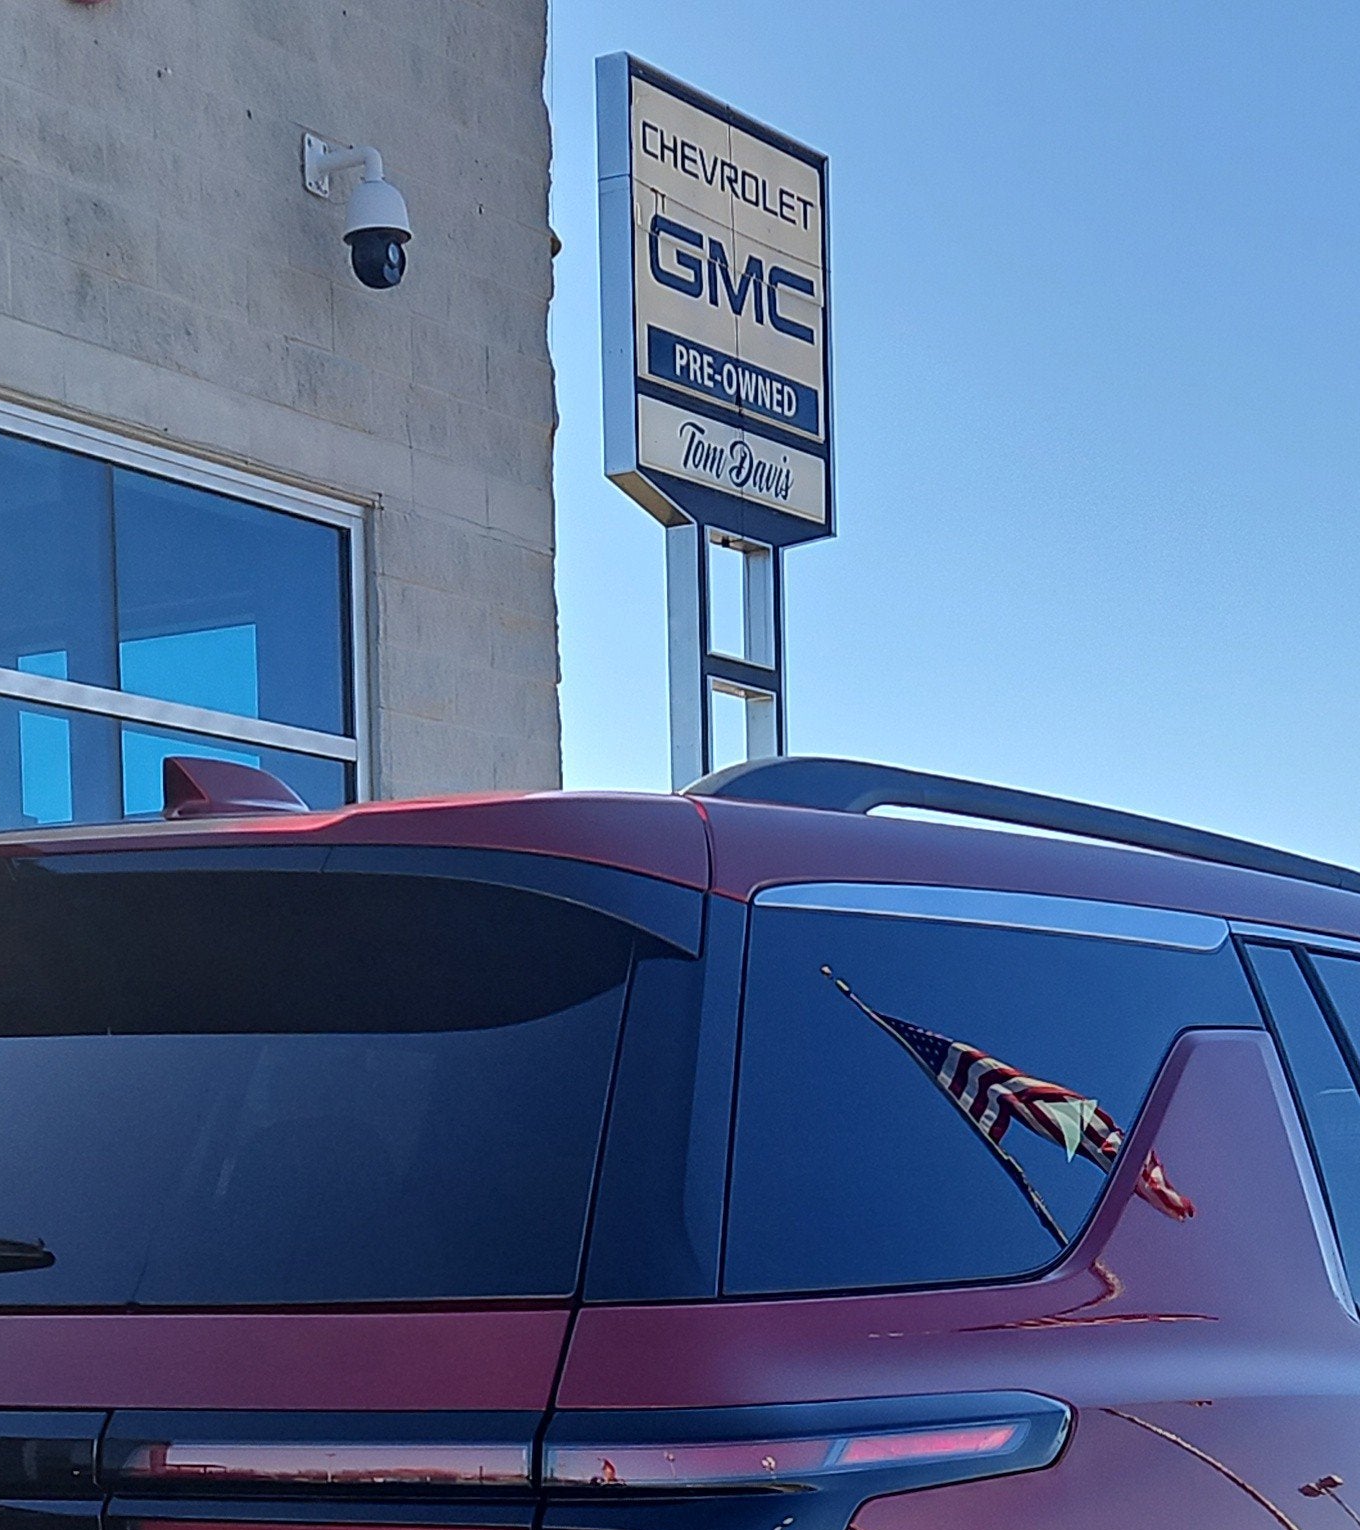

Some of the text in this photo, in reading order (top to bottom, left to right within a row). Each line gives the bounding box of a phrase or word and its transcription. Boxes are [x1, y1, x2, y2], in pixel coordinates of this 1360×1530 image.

[641, 120, 814, 231] CHEVROLET
[648, 213, 815, 346] GMC
[675, 342, 798, 418] PRE-OWNED
[679, 421, 795, 501] Tom Davis
